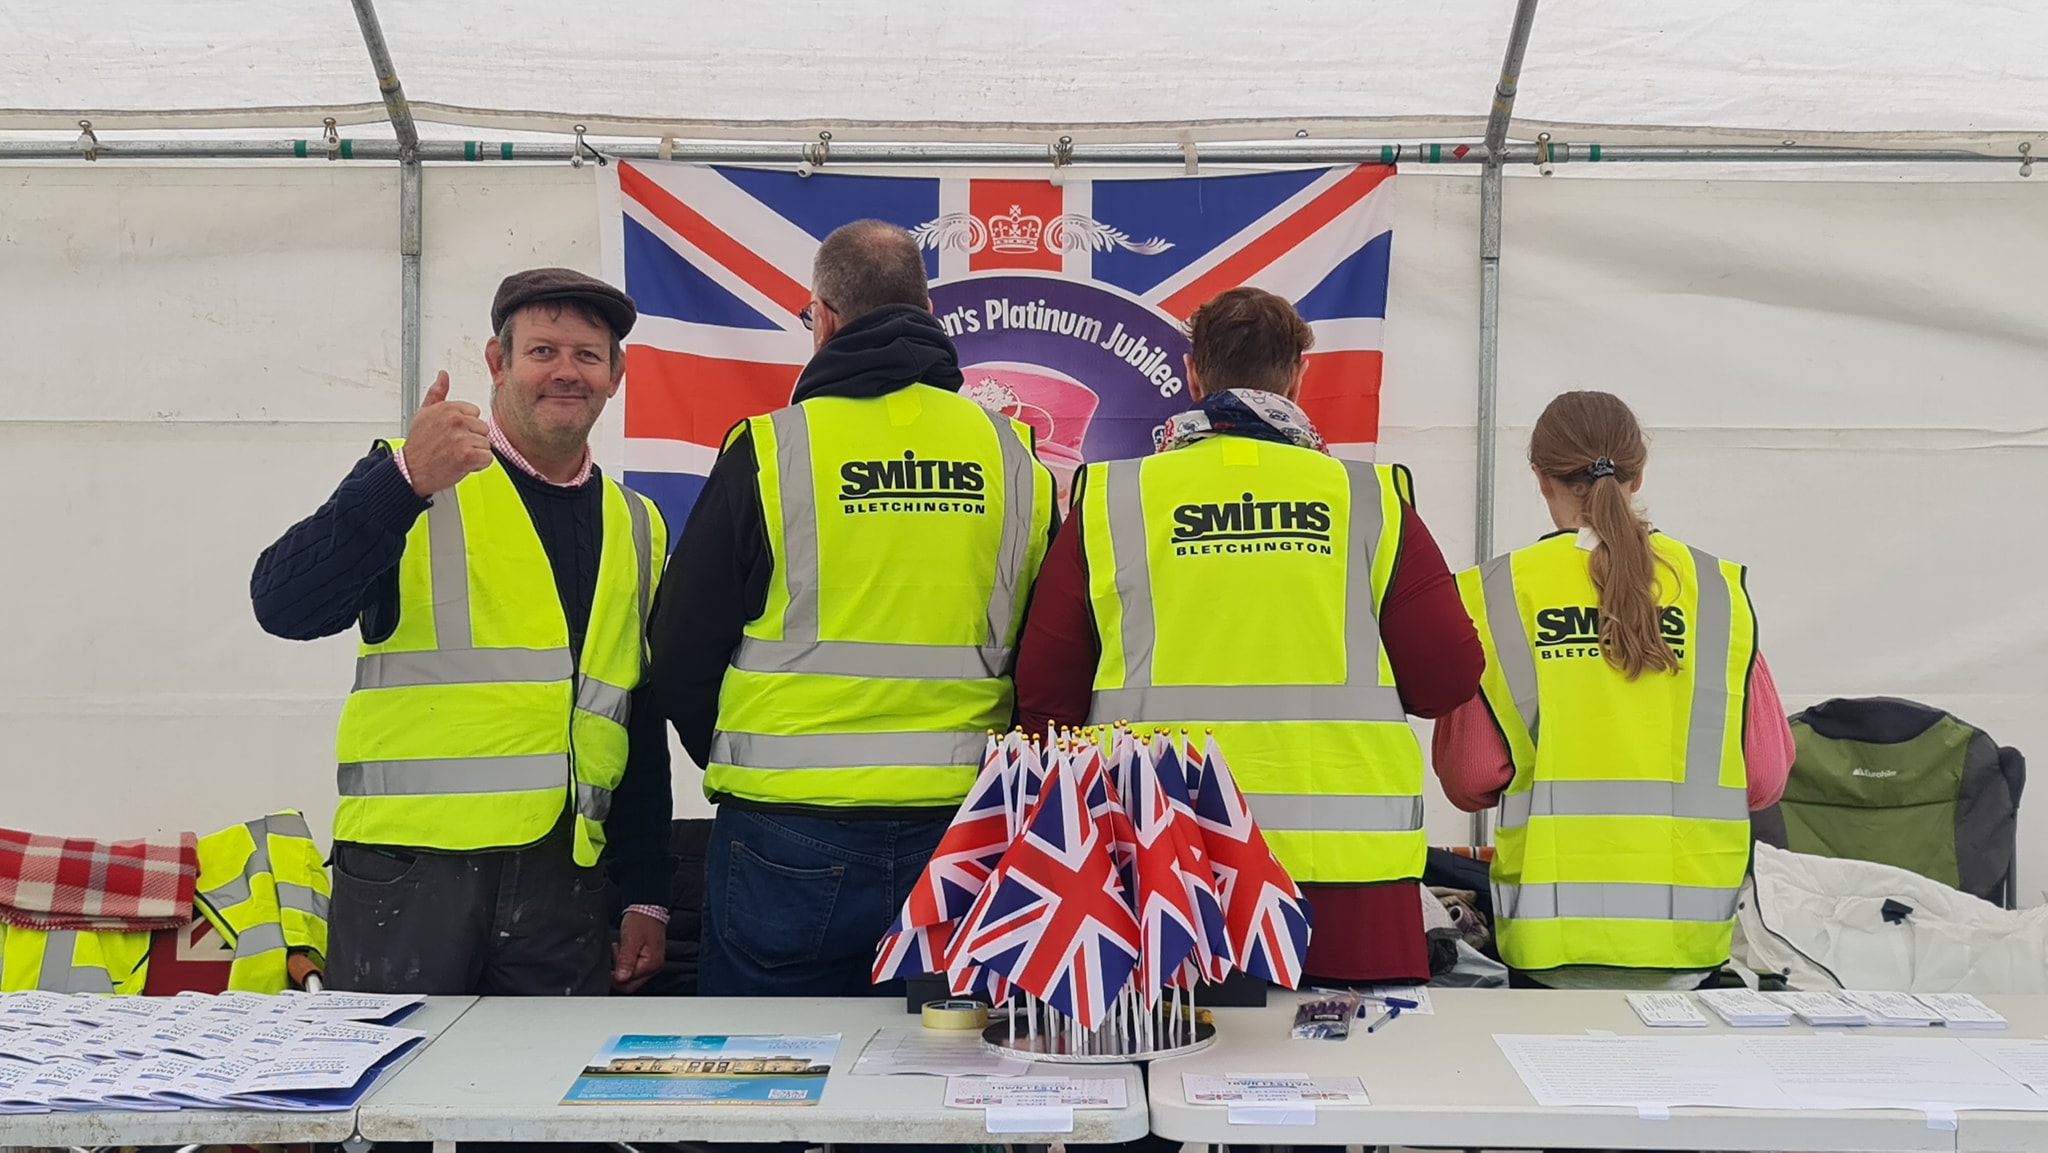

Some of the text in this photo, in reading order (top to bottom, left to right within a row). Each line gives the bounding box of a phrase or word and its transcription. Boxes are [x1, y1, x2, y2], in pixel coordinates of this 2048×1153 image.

[985, 298, 1102, 344] Platinum
[1101, 322, 1183, 398] Jubilee
[844, 502, 985, 514] BLETCHINGTON
[1176, 541, 1332, 556] BLETCHINGTON
[1536, 606, 1686, 643] SMS
